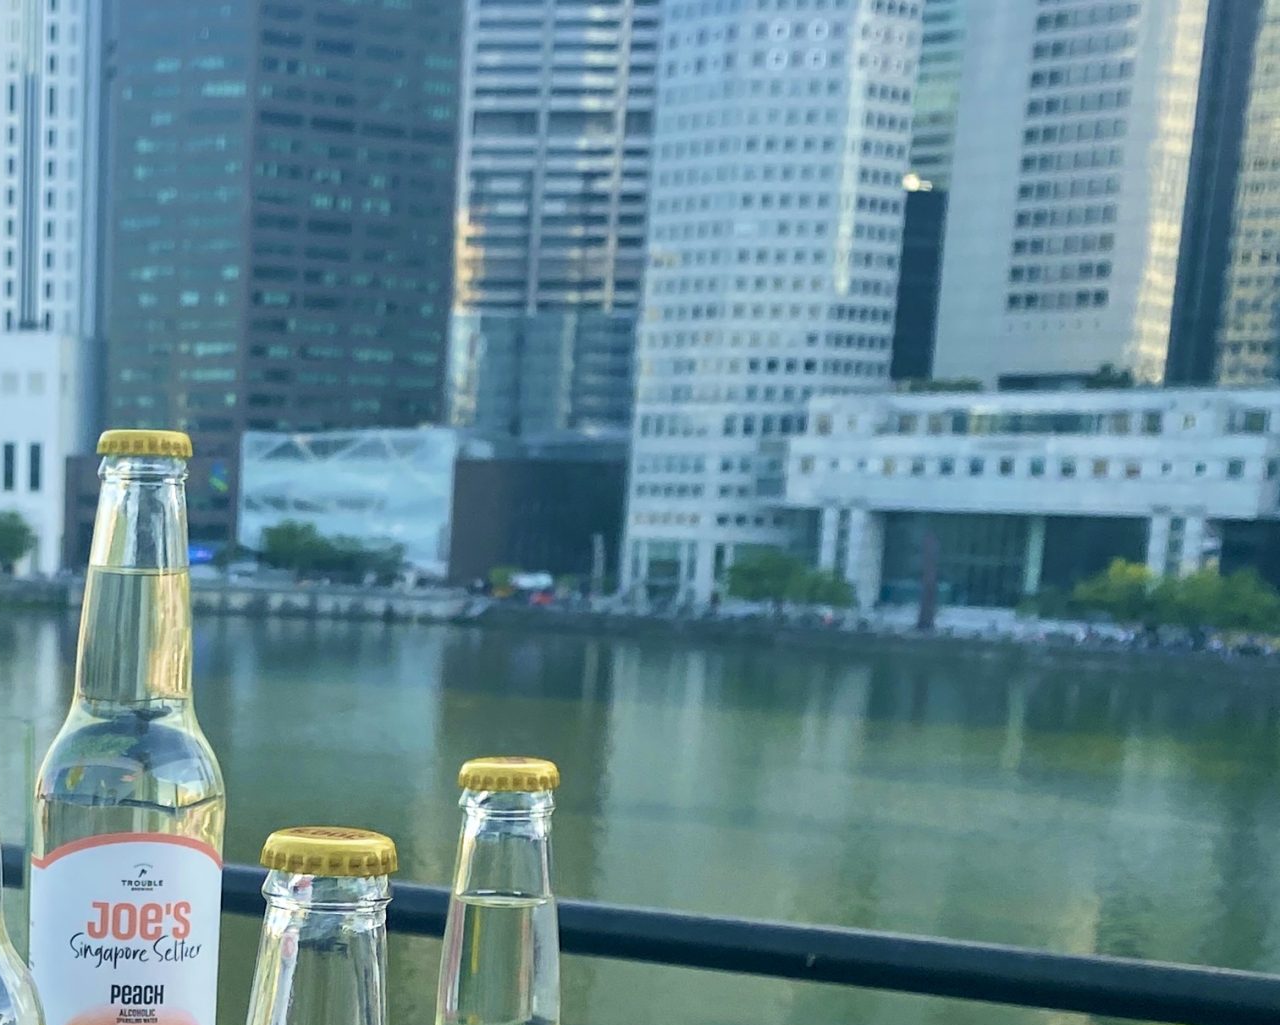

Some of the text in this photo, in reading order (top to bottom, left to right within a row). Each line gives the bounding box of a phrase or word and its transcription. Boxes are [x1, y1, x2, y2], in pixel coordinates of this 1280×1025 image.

[121, 879, 163, 888] TROUBLE
[69, 932, 202, 969] Singapore Seltzer
